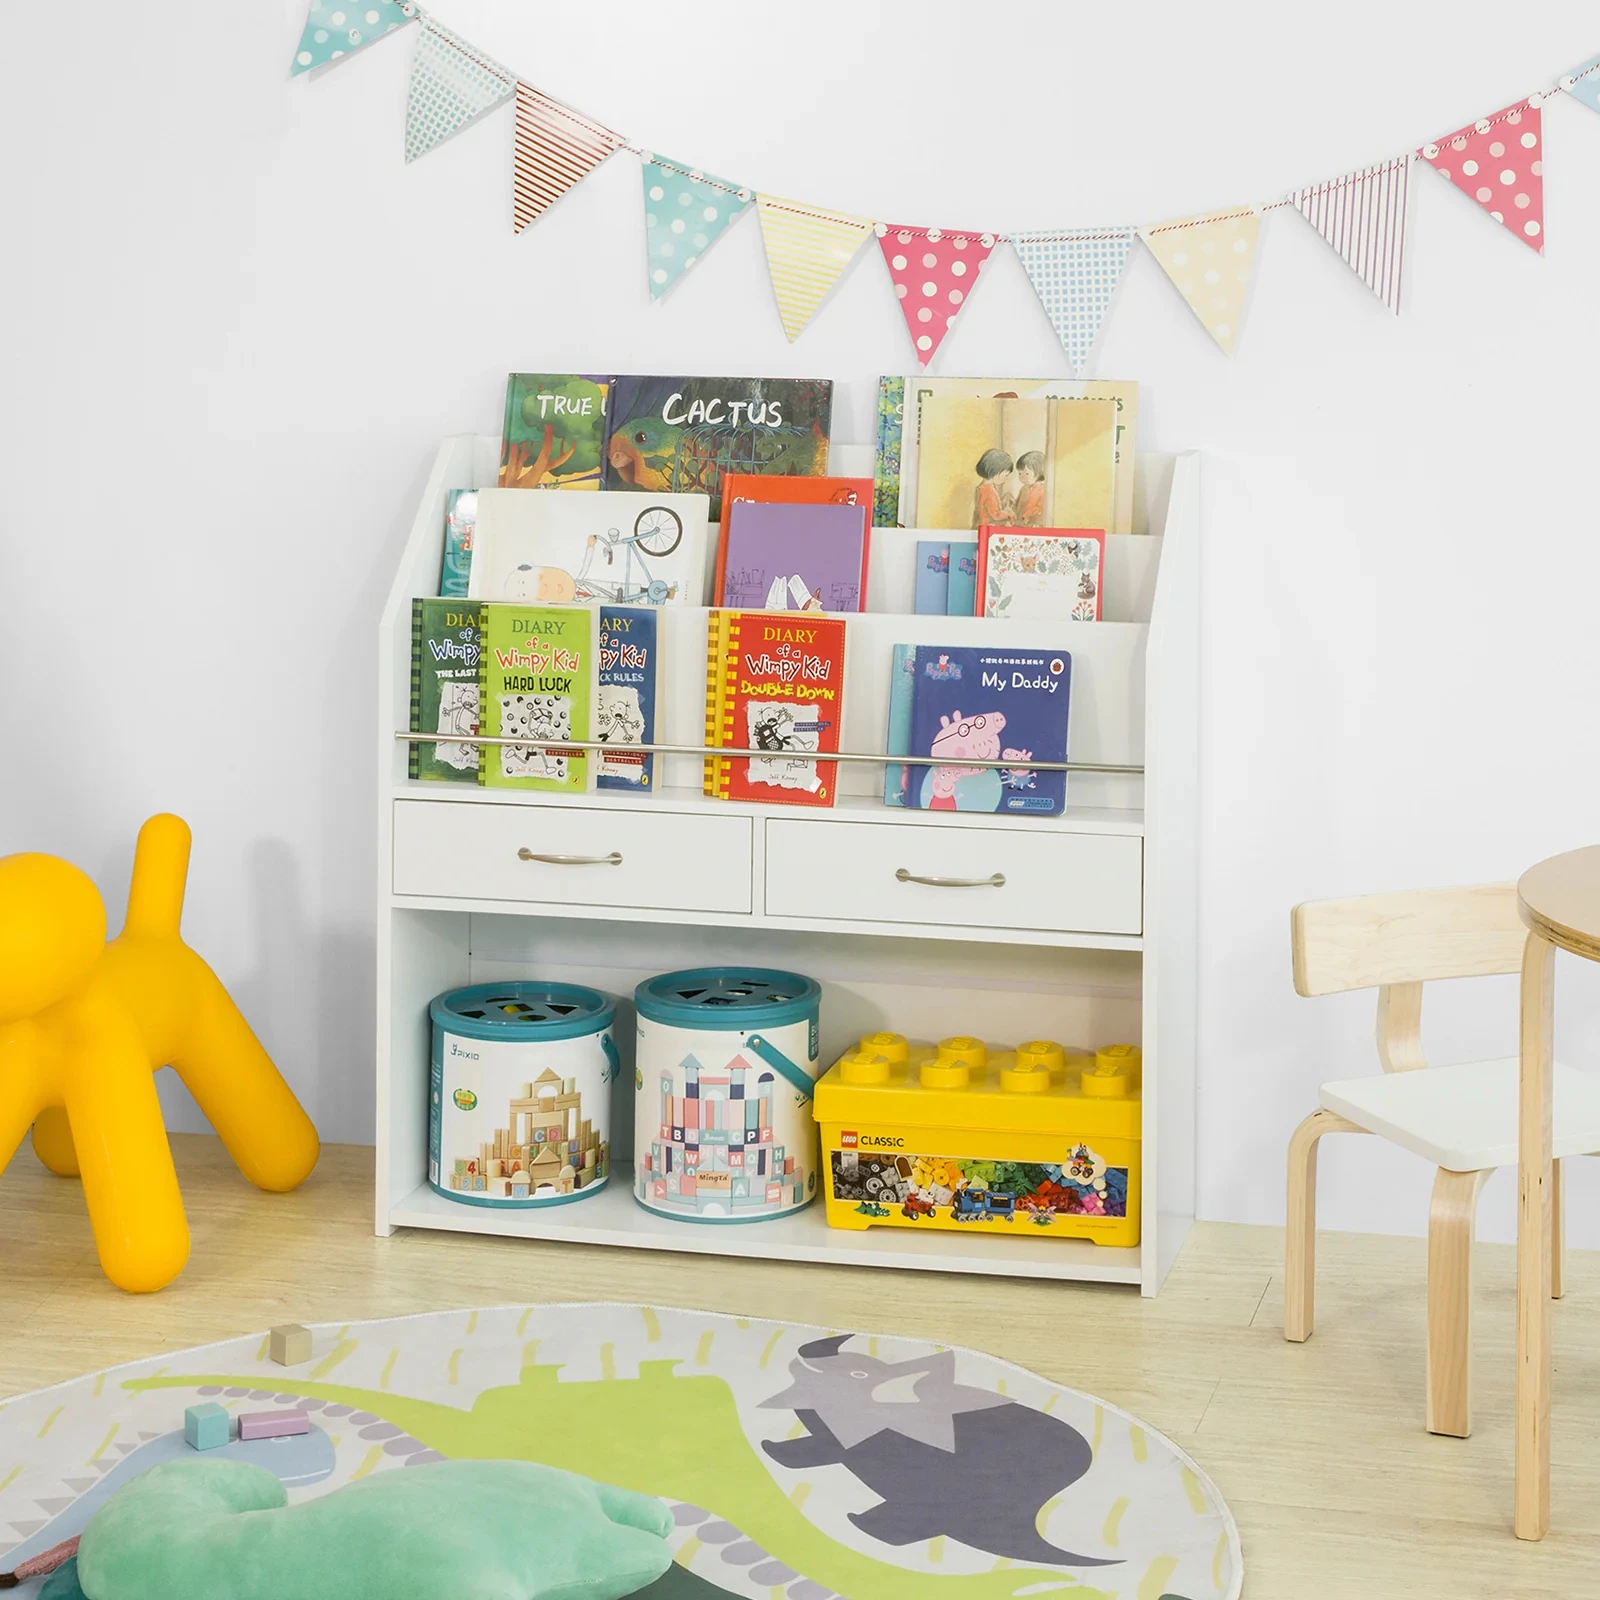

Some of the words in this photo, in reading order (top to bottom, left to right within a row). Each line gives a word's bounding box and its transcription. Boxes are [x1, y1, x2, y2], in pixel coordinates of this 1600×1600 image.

[537, 394, 593, 420] TRUE
[662, 393, 783, 429] CACTUS
[511, 619, 567, 635] DIARY
[459, 628, 473, 641] of
[763, 627, 818, 643] DIARY
[526, 636, 539, 650] of
[610, 638, 619, 646] a
[429, 639, 481, 665] Wimpy
[621, 643, 647, 669] Kid
[776, 643, 790, 658] of
[792, 649, 801, 658] a
[494, 648, 550, 675] Wimpy
[552, 648, 580, 673] Kid
[745, 654, 801, 682] Wimpy
[801, 655, 831, 680] Kid
[435, 670, 453, 679] THE
[455, 669, 477, 678] LAST
[613, 673, 645, 683] RULES
[503, 675, 535, 692] HARD
[539, 677, 572, 693] LUCK
[982, 671, 1007, 692] My
[1011, 671, 1059, 694] Daddy
[603, 750, 648, 758] INTERNATIONAL
[534, 1129, 546, 1143] C
[549, 1127, 561, 1141] D
[673, 1129, 682, 1141] B
[747, 1130, 756, 1142] P
[762, 1129, 770, 1141] F
[842, 1135, 857, 1143] LEGO
[860, 1135, 904, 1148] CLASSIC
[685, 1153, 698, 1165] W
[731, 1154, 742, 1166] M
[467, 1161, 476, 1174] 4
[699, 1173, 729, 1182] MingTa
